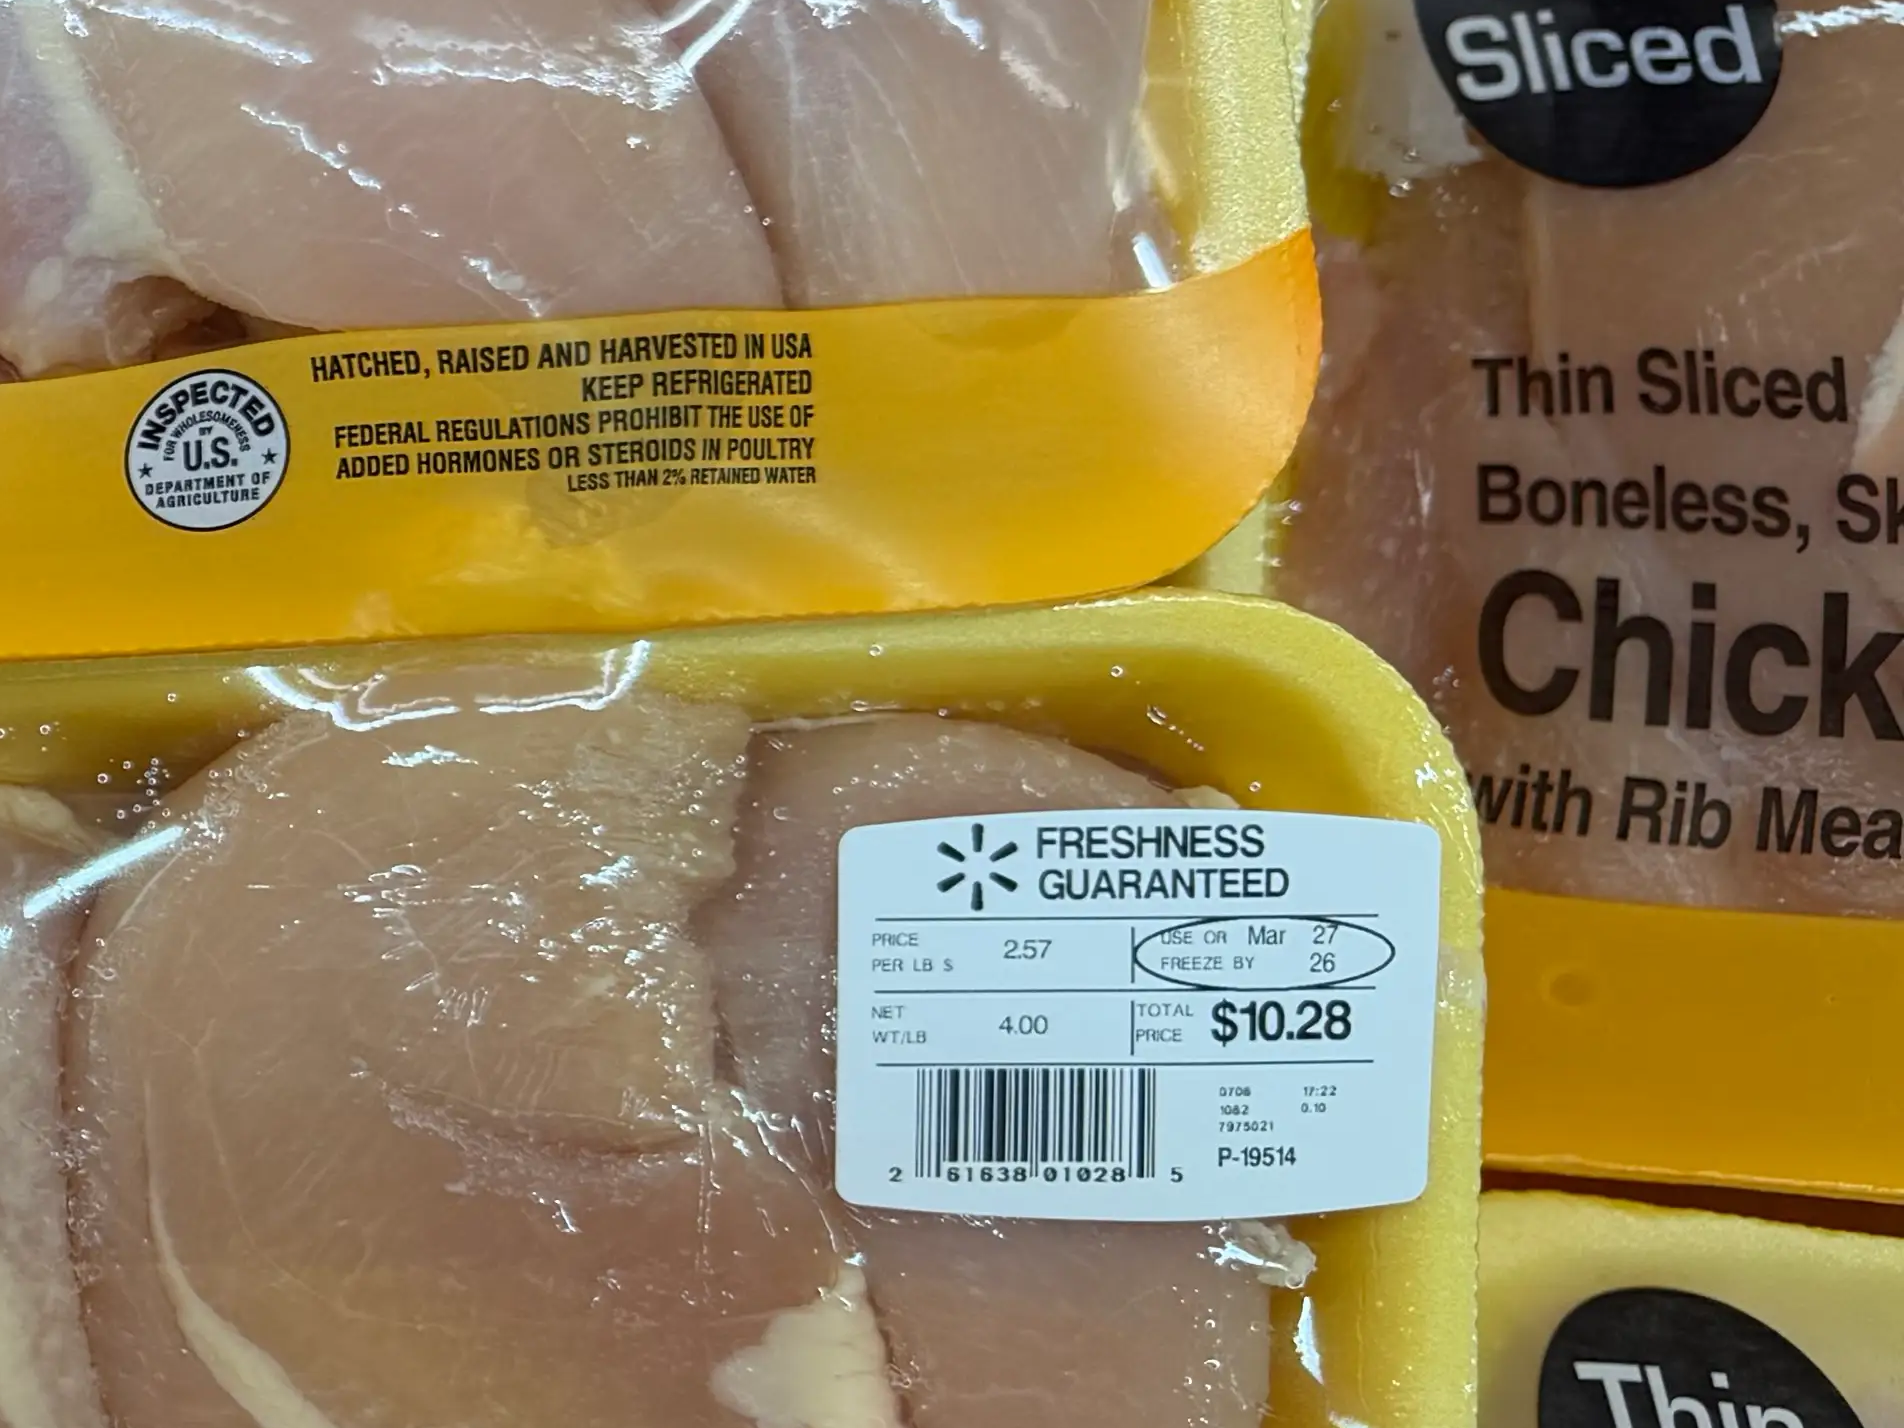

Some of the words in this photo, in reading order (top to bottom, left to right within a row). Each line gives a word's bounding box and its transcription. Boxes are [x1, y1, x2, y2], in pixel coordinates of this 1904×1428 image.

[1445, 4, 1762, 101] Sliced
[311, 350, 432, 383] HATCHED,
[437, 346, 529, 376] RAISED
[541, 342, 591, 367] AND
[600, 334, 736, 364] HARVESTED
[744, 334, 764, 360] IN
[769, 333, 812, 360] USA
[581, 376, 644, 402] KEEP
[653, 370, 812, 398] REFRIGERATED
[1471, 353, 1615, 418] Thin
[1637, 348, 1847, 423] Sliced
[136, 380, 275, 451] INSPECTED
[334, 421, 431, 449] FEDERAL
[437, 412, 590, 444] REGULATIONS
[597, 406, 700, 434] PROHIBIT
[707, 406, 741, 430] THE
[748, 405, 784, 430] USE
[790, 404, 814, 428] OF
[183, 436, 238, 471] U.S.
[1476, 464, 1810, 553] Boneless,
[1477, 568, 1904, 740] Chick
[1467, 763, 1592, 837] with
[1616, 775, 1731, 848] Rib
[1755, 786, 1904, 860] Mea
[1037, 824, 1265, 859] FRESHNESS
[1038, 868, 1289, 899] GUARANTEED
[872, 933, 919, 947] PRICE
[1160, 930, 1193, 945] USE
[1204, 930, 1227, 944] OR
[1248, 925, 1285, 946] Mar
[1313, 925, 1338, 945] 27
[1003, 939, 1052, 960] 2.57
[1161, 955, 1226, 970] FREEZE
[1233, 955, 1255, 970] BY
[1309, 952, 1335, 973] 26
[872, 958, 904, 972] PER
[913, 958, 933, 972] LB
[943, 957, 953, 972] $
[872, 1005, 904, 1019] NET
[1138, 1003, 1194, 1018] TOTAL
[1212, 999, 1352, 1046] $10.28
[872, 1030, 926, 1045] WT/LB
[998, 1015, 1048, 1035] 4.00
[1135, 1027, 1183, 1043] PRICE
[1218, 1146, 1297, 1168] P-19514
[889, 1167, 902, 1182] 2
[947, 1166, 1028, 1183] 61638
[1043, 1166, 1126, 1182] 01028
[1170, 1167, 1183, 1182] 5
